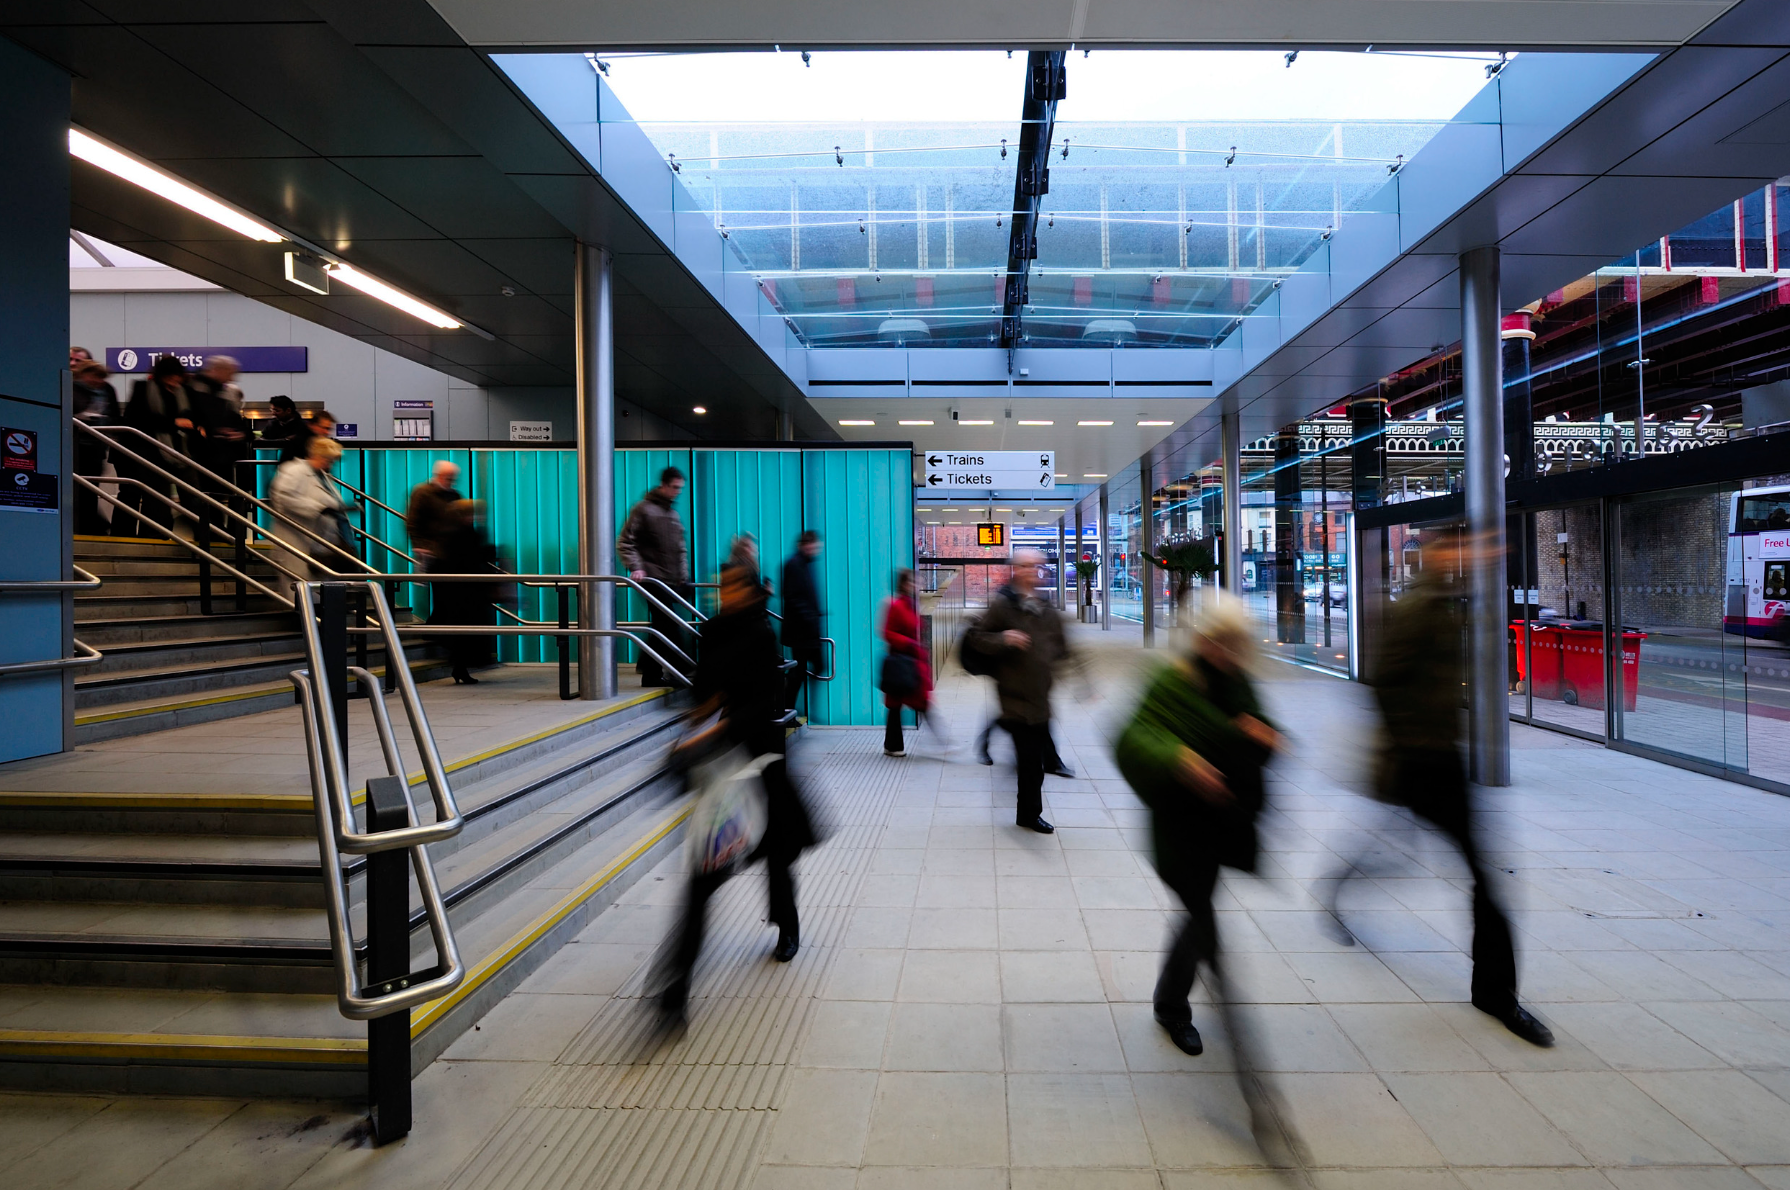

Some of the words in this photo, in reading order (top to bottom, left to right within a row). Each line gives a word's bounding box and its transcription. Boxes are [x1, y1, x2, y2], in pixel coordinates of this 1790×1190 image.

[148, 352, 203, 367] Tiets
[947, 455, 984, 465] Trains
[947, 474, 992, 484] Tickets
[1764, 539, 1784, 547] Free
